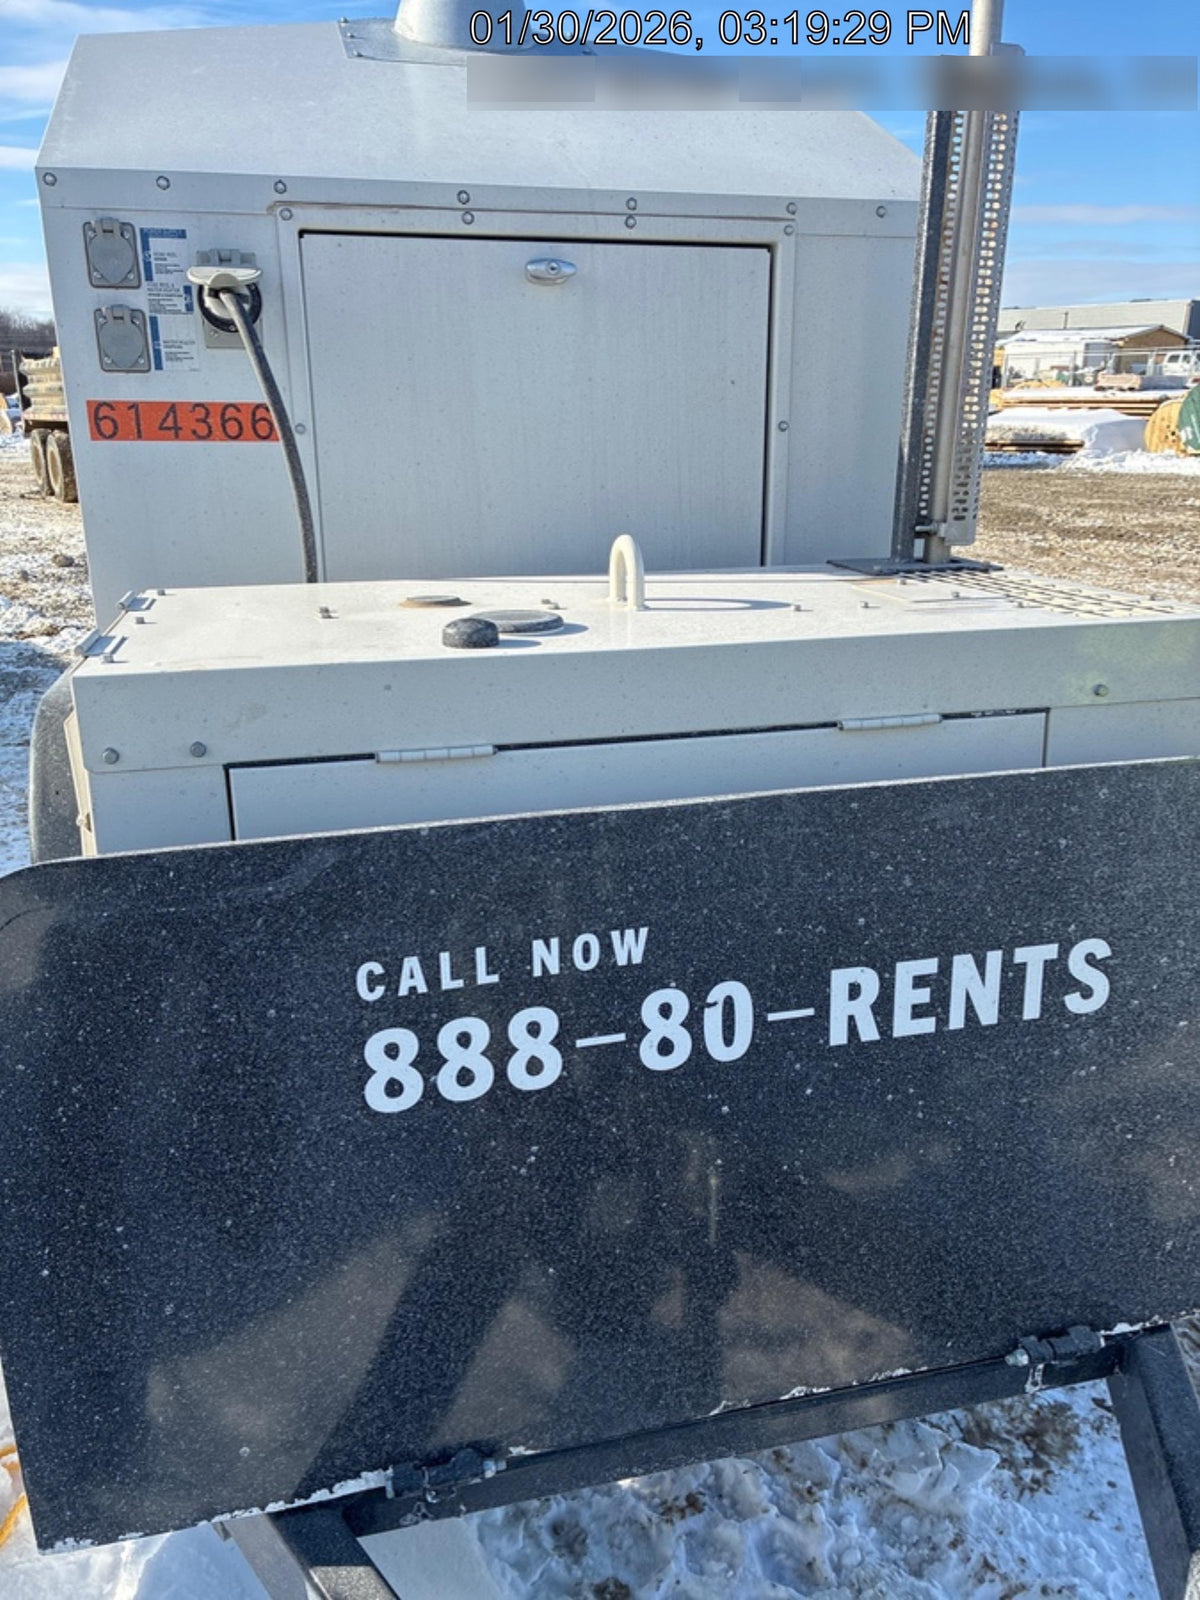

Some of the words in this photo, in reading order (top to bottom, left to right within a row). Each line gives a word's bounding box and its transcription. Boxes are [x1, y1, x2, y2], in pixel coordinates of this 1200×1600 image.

[93, 402, 275, 440] 614366
[356, 946, 500, 1001] CALL
[532, 926, 650, 977] NOW
[363, 938, 1113, 1114] 888-80-RENTS
